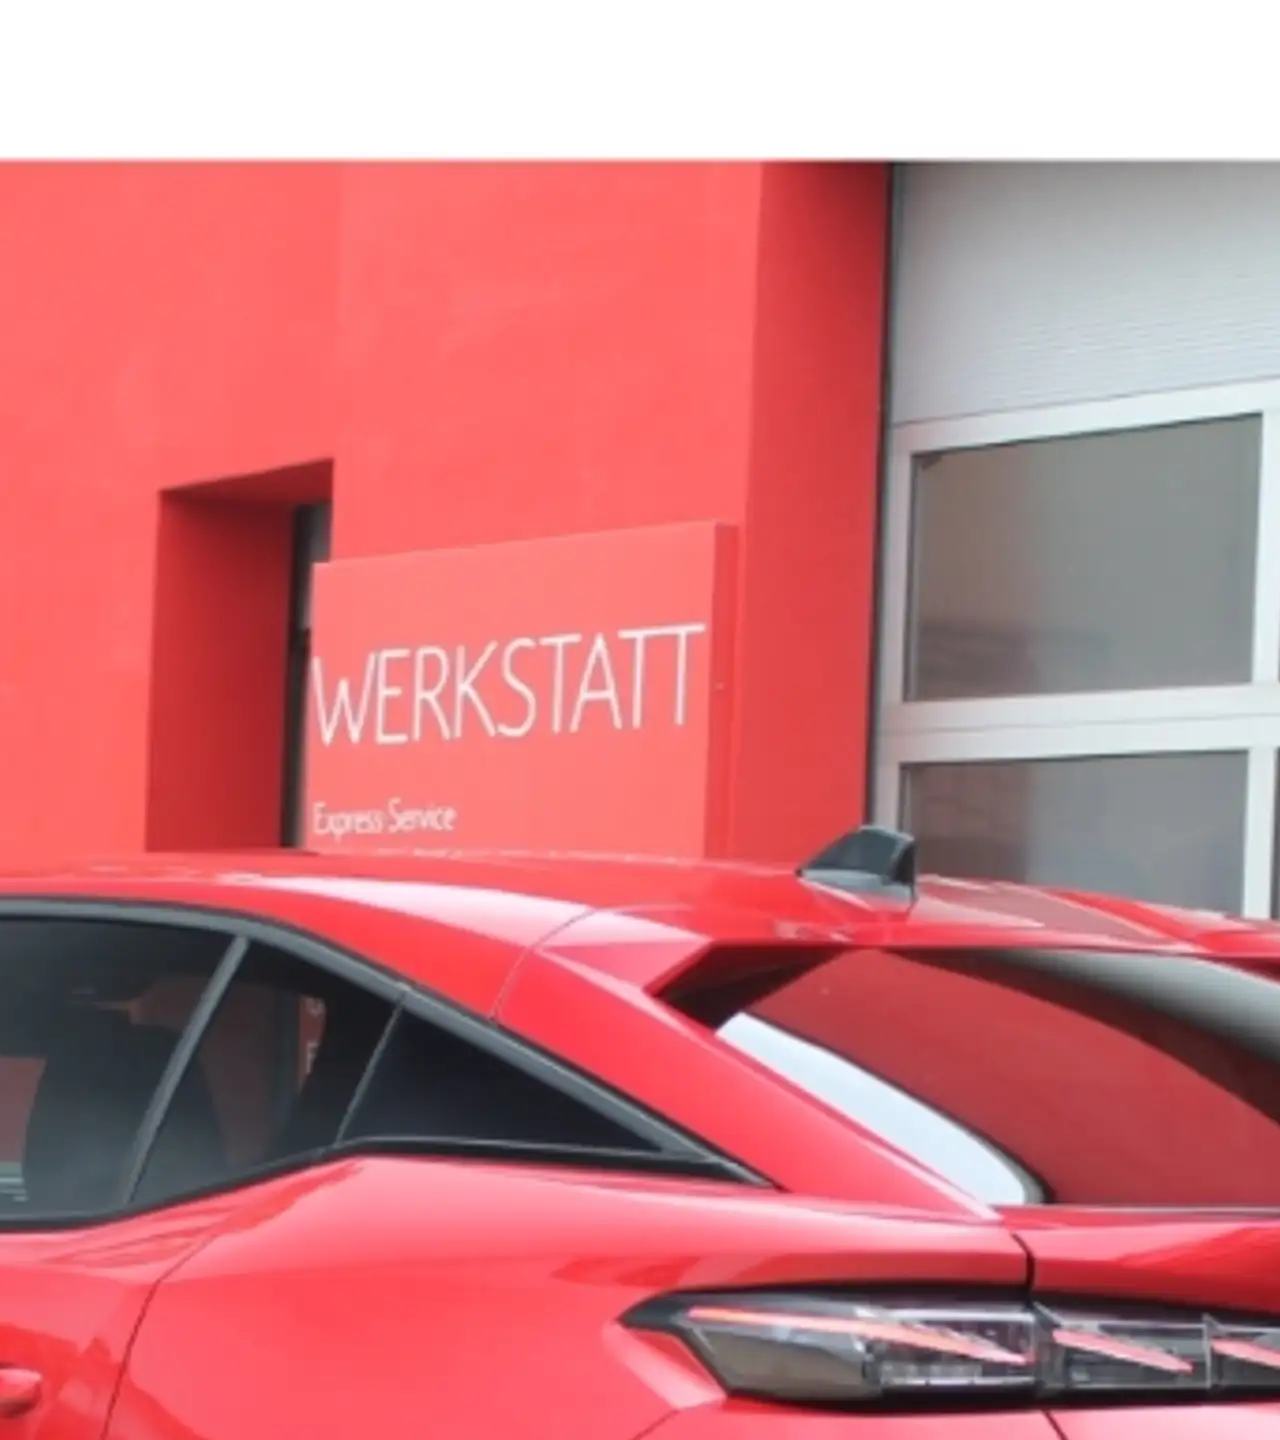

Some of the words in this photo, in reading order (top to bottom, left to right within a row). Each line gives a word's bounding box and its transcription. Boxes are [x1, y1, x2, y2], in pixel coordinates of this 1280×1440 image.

[311, 623, 706, 746] WERKSTATT
[313, 802, 383, 842] Express
[387, 797, 457, 833] Service
